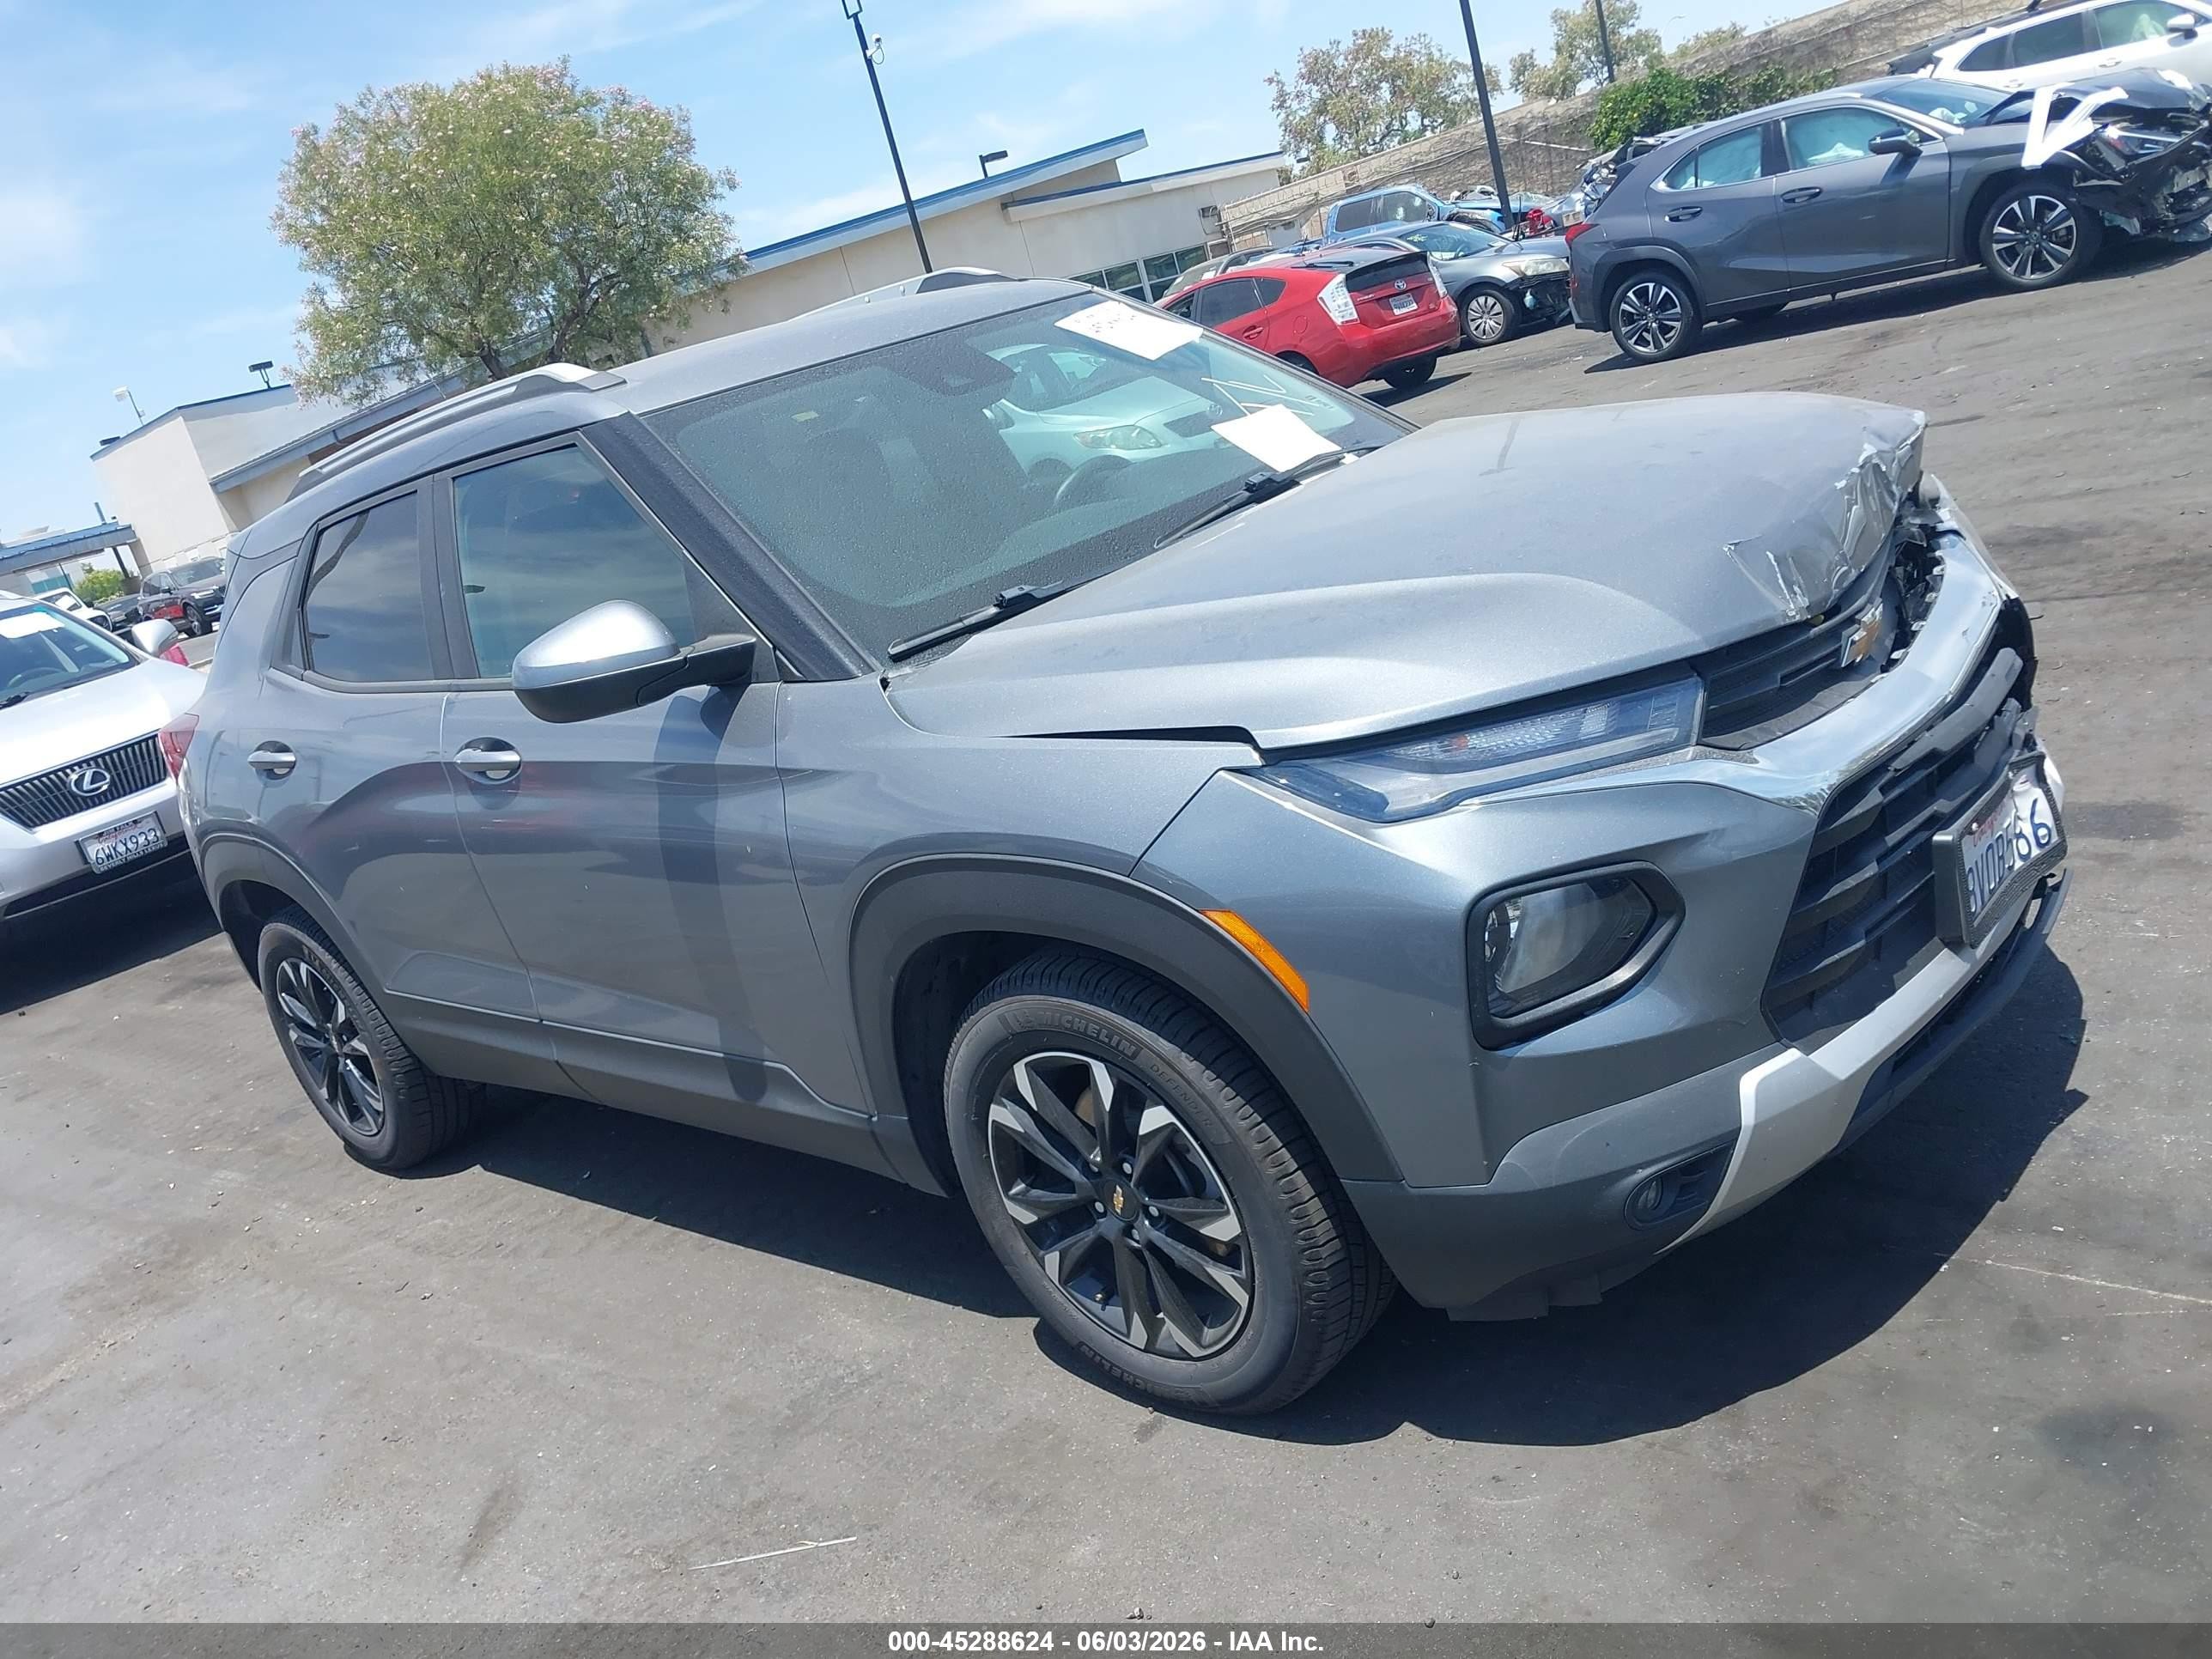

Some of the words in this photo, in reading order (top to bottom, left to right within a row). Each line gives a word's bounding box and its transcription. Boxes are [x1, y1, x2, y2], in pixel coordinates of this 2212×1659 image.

[94, 828, 160, 866] 6WKX933
[1036, 1012, 1139, 1058] MICHELIN
[1149, 1063, 1213, 1128] DEFENDER
